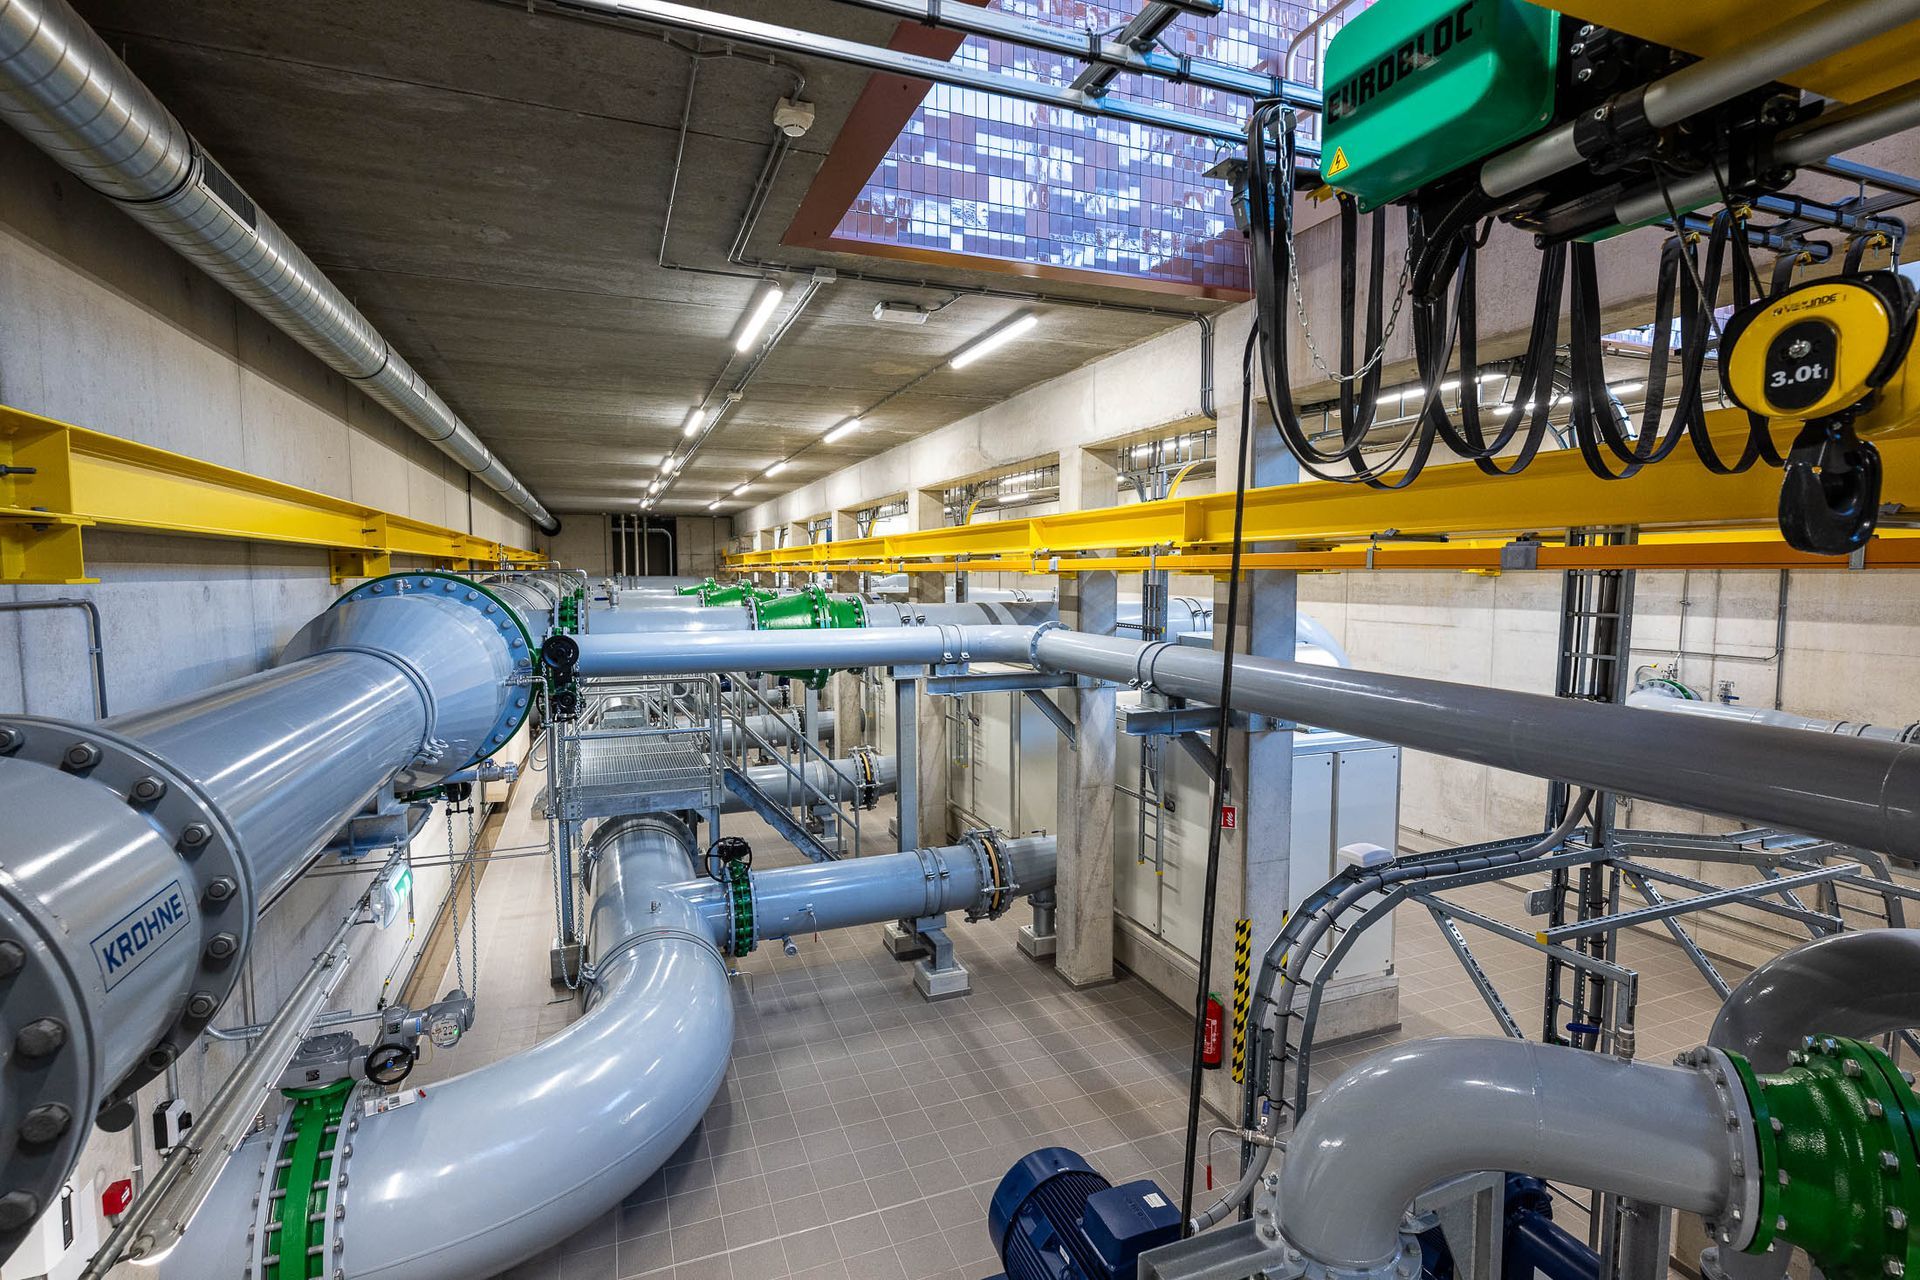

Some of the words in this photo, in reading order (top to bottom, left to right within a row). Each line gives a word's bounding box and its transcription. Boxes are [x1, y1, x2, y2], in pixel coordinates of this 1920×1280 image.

[1328, 3, 1473, 124] EUROBLOC
[1771, 364, 1822, 388] 3.0t
[102, 893, 184, 974] KROHNE
